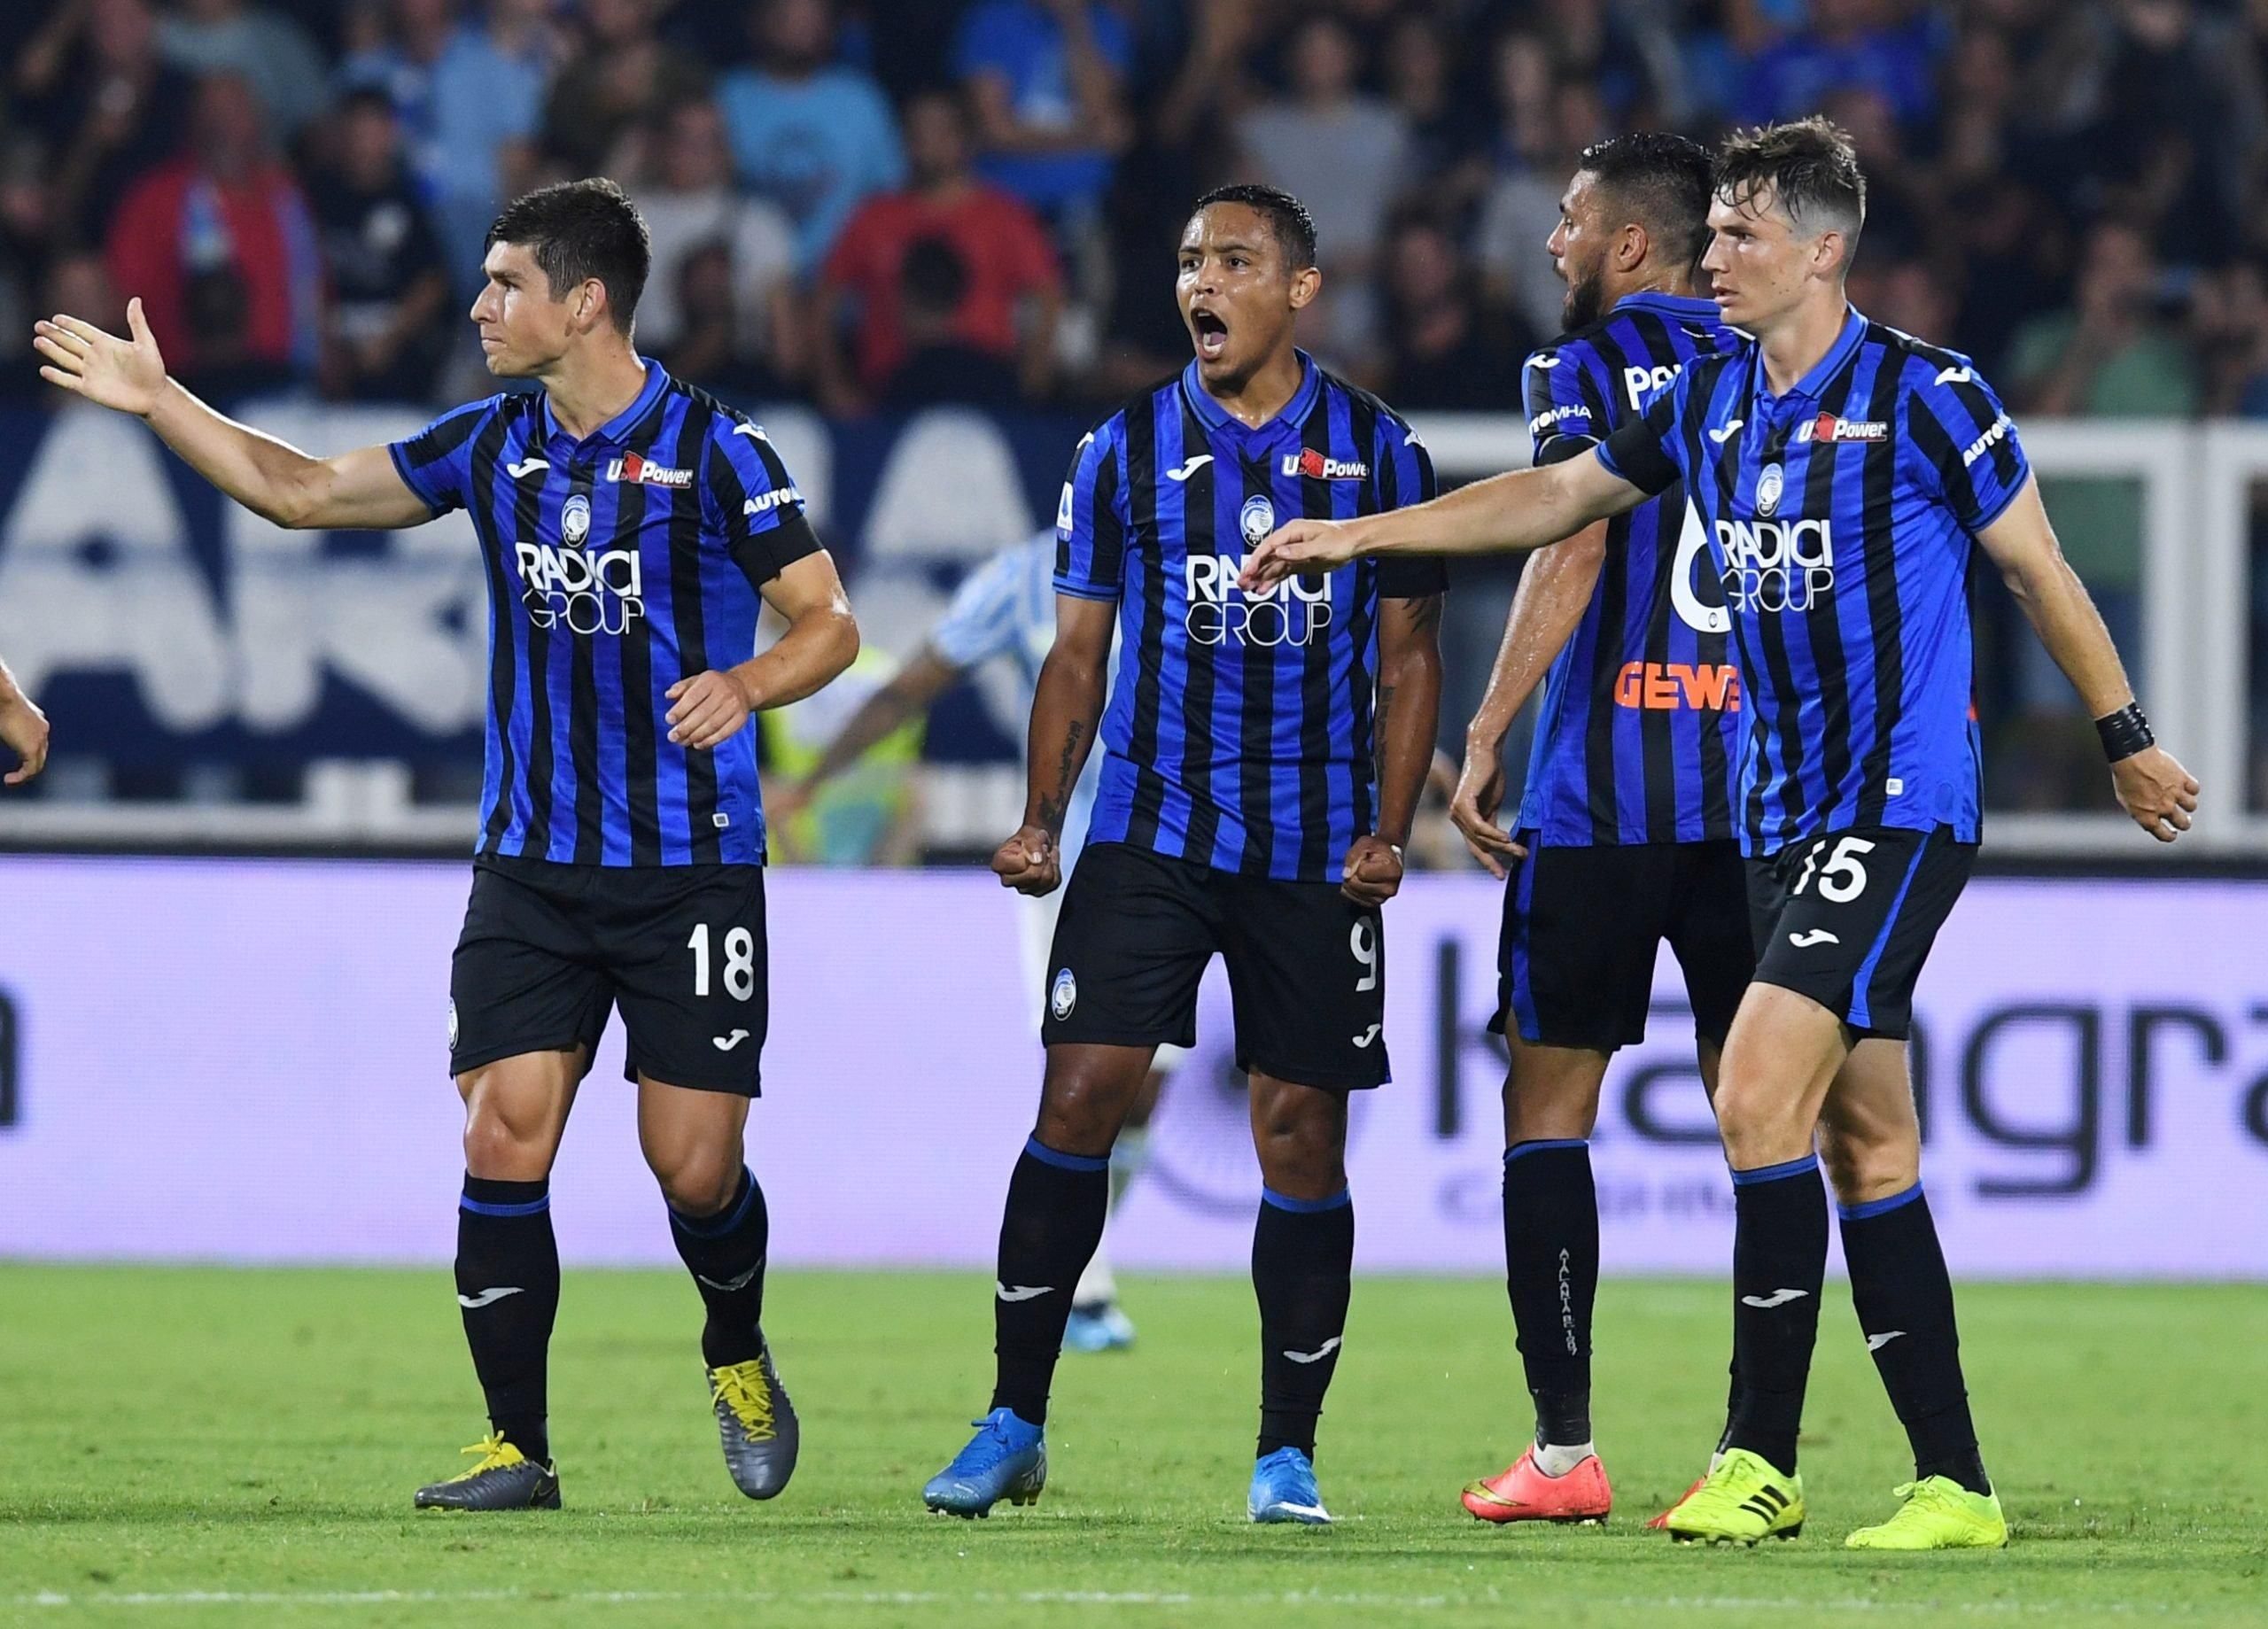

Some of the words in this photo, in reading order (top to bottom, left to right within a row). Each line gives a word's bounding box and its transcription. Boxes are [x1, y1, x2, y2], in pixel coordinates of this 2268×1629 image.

[1624, 364, 1682, 411] PA
[1528, 404, 1592, 436] TOMHA
[1830, 419, 1888, 441] Power
[1962, 413, 2009, 468] AUTO
[638, 461, 693, 485] Power
[1321, 458, 1370, 478] Powe
[742, 486, 796, 516] AUTO
[1714, 519, 1834, 569] RADICI
[515, 542, 641, 597] RADICI
[1720, 567, 1835, 613] GROUP
[522, 588, 645, 635] GROUP
[1184, 601, 1333, 648] GROUP
[687, 922, 755, 1002] 18
[1349, 915, 1377, 993] 9
